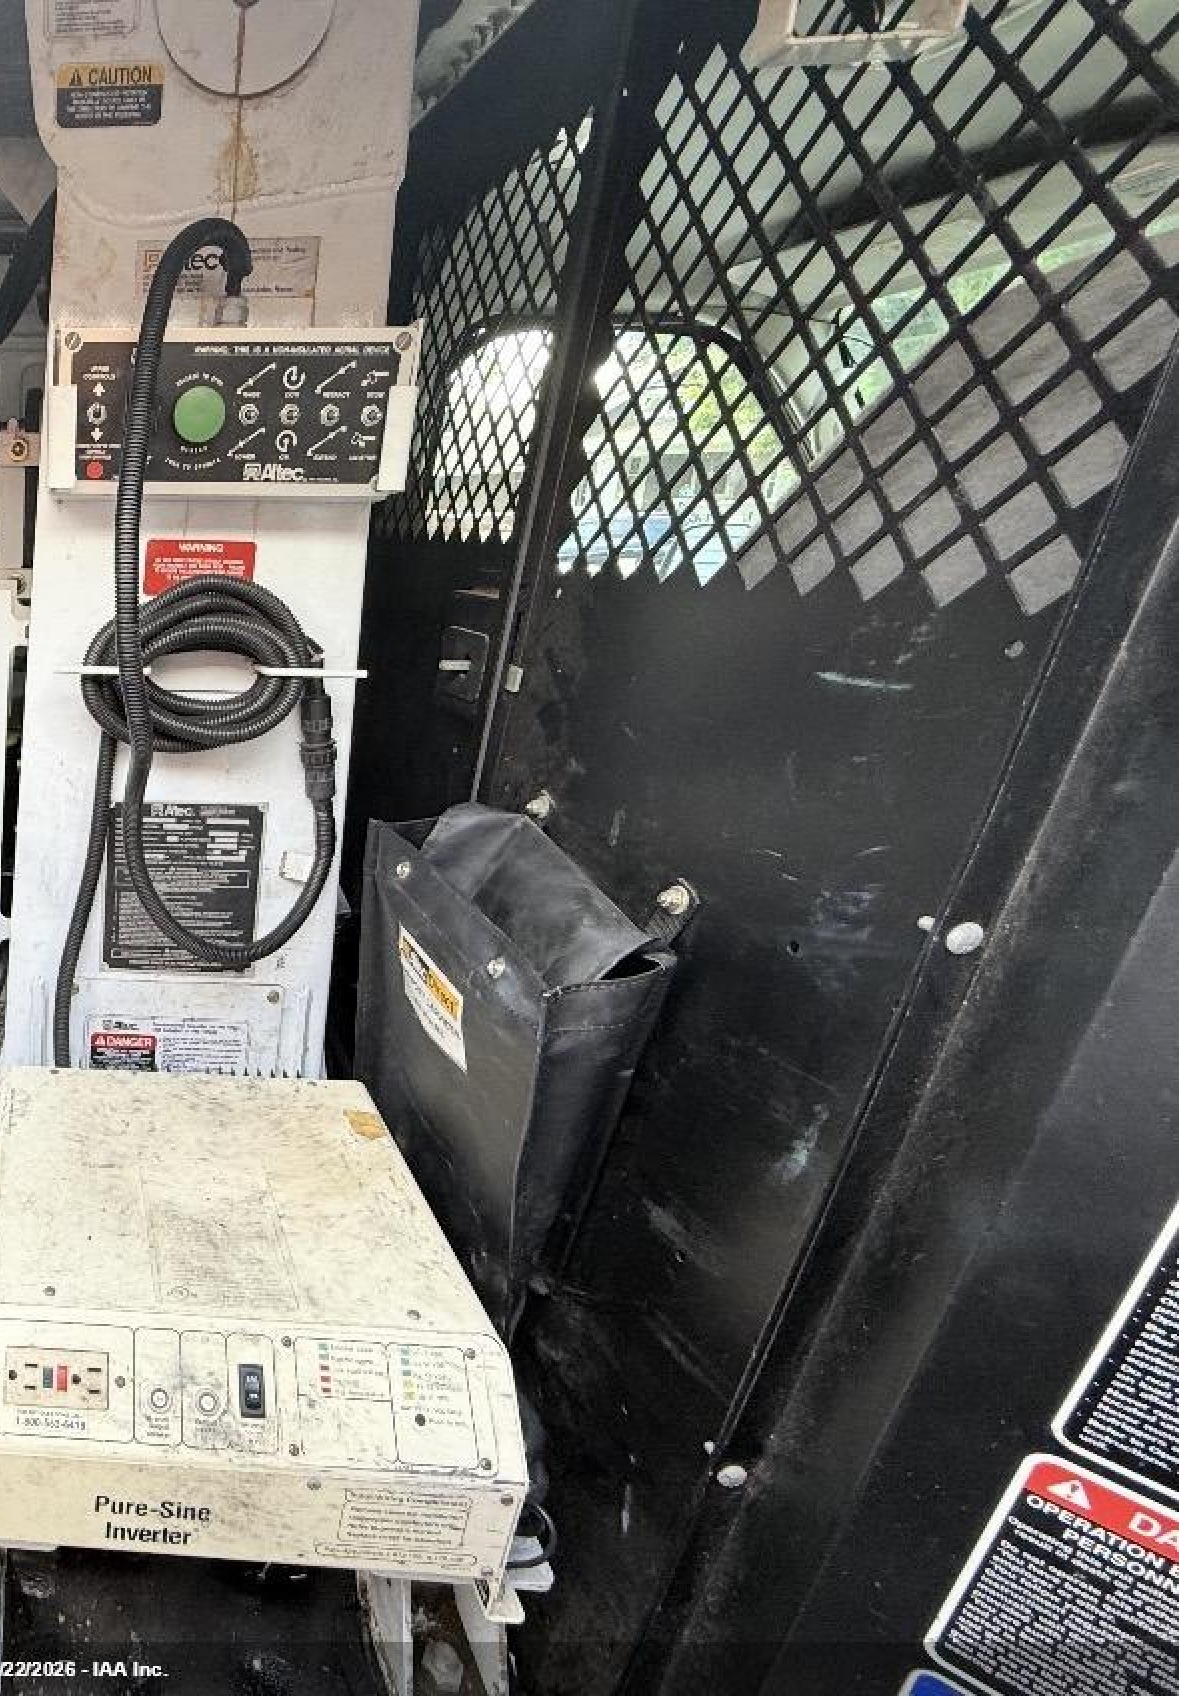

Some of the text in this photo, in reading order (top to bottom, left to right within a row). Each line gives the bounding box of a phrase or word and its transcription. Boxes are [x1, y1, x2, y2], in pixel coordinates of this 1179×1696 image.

[89, 65, 152, 85] CAUTION
[261, 463, 304, 481] Altec
[178, 543, 224, 553] WARNING
[107, 1035, 153, 1047] DANGER
[94, 1494, 211, 1522] Pure-Sine
[104, 1521, 192, 1545] Inverter
[1026, 1494, 1167, 1570] OPERATION
